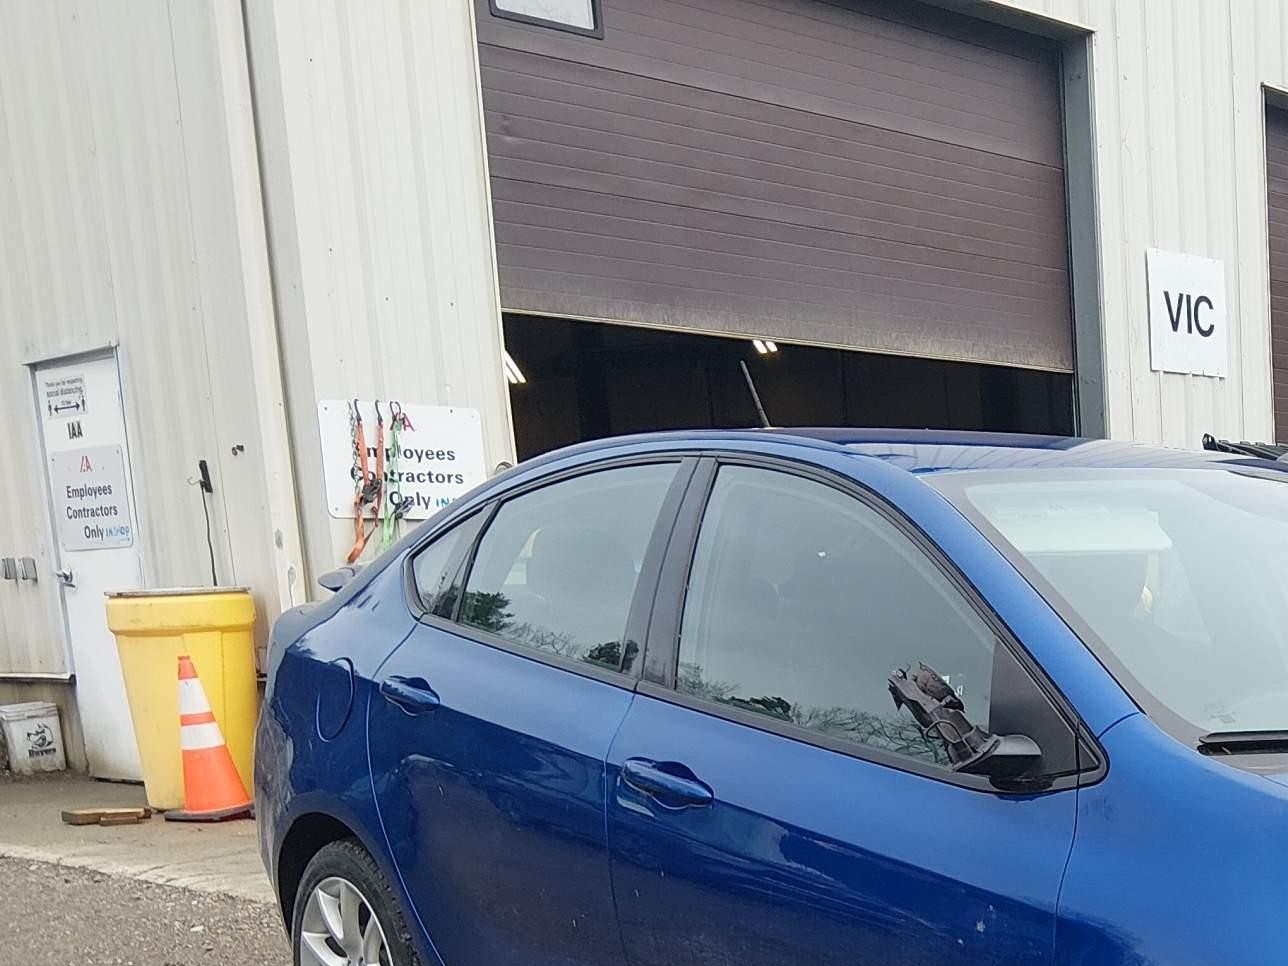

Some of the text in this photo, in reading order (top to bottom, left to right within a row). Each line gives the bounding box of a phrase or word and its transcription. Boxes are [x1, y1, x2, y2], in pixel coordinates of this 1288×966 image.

[1163, 290, 1215, 337] VIC
[67, 421, 83, 439] IAA
[66, 483, 113, 500] Employees
[66, 505, 118, 519] Contractors
[84, 525, 104, 541] Only
